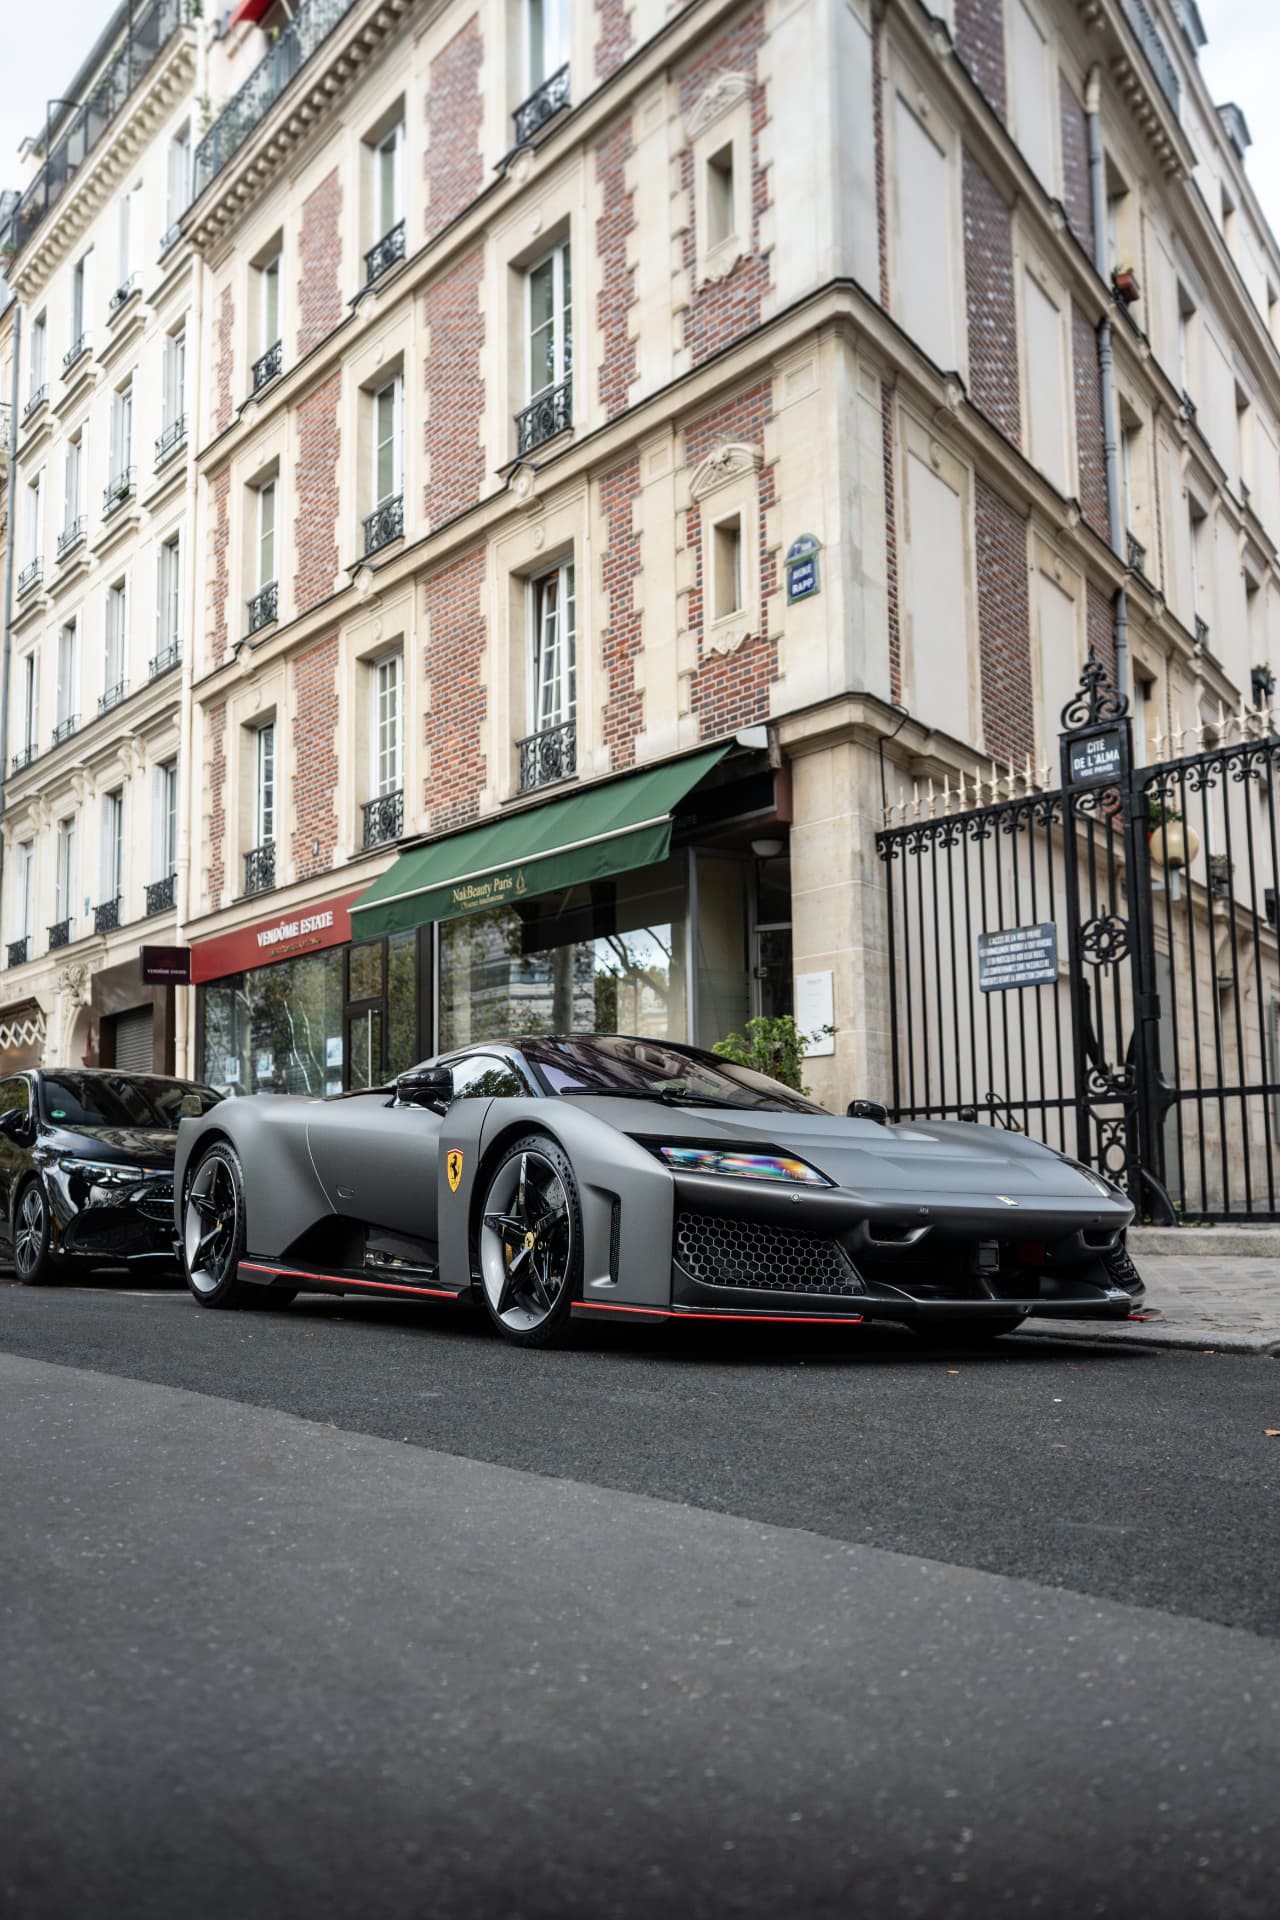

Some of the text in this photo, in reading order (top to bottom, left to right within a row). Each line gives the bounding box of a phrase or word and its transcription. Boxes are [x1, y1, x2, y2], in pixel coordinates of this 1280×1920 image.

[792, 577, 814, 595] RAPP
[1087, 738, 1106, 754] CITÉ
[1073, 749, 1120, 770] DE L'ALMA
[493, 874, 513, 892] Paris
[257, 921, 300, 947] VENDÔME
[300, 911, 334, 935] ESTATE
